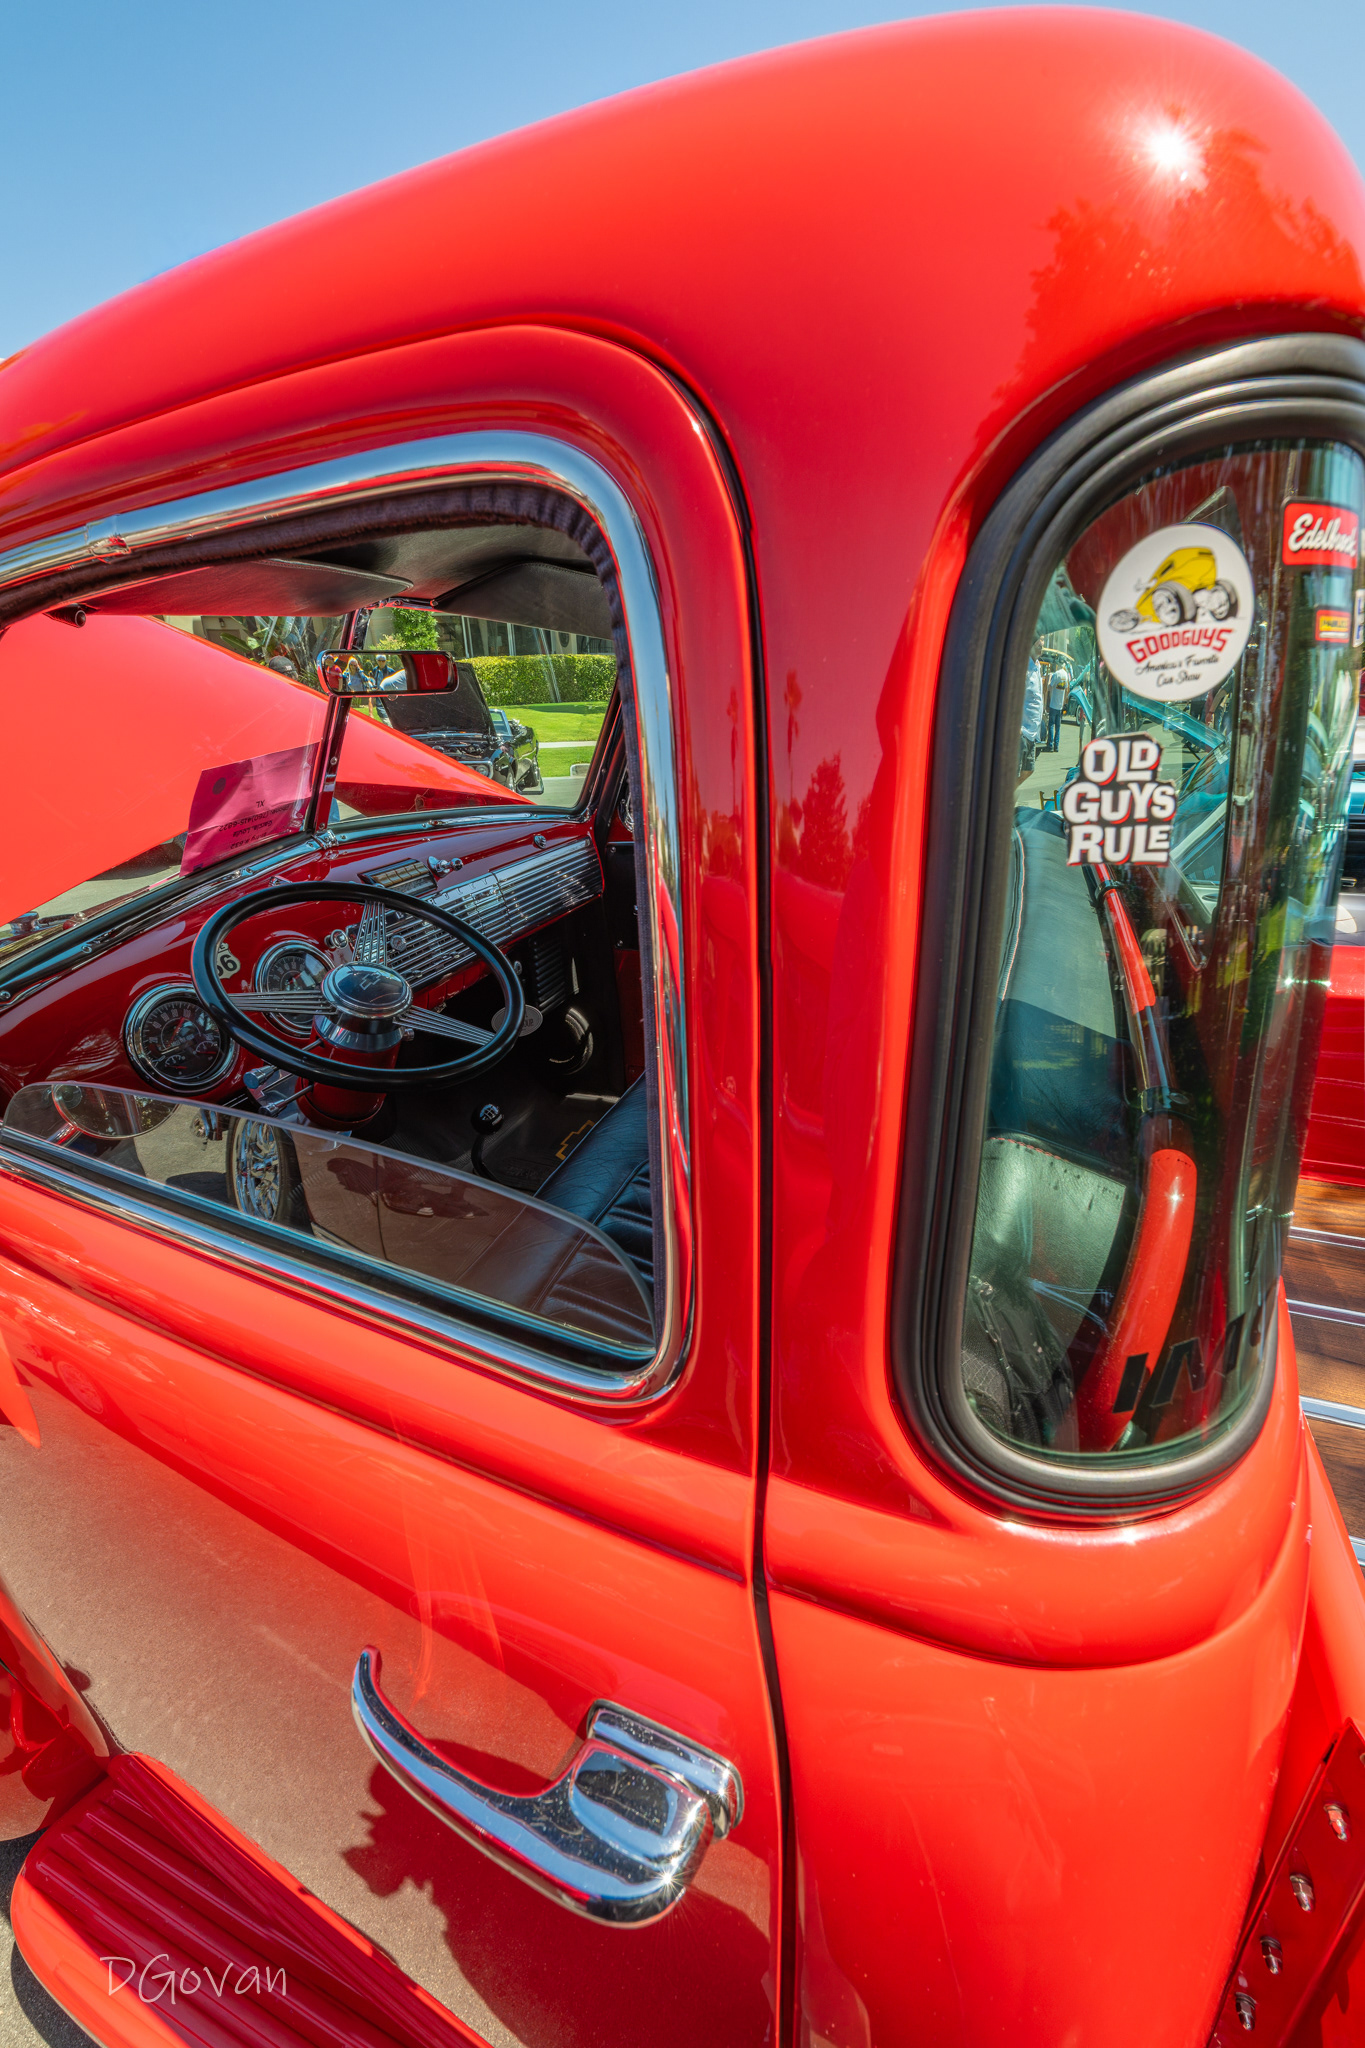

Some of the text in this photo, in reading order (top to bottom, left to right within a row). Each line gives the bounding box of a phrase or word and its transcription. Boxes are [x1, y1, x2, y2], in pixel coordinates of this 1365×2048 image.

[1125, 627, 1234, 664] GOODGUYS
[1156, 670, 1202, 687] Car Show
[1084, 739, 1161, 784] OLD
[1063, 781, 1177, 824] GUYS
[1067, 824, 1170, 866] RULE
